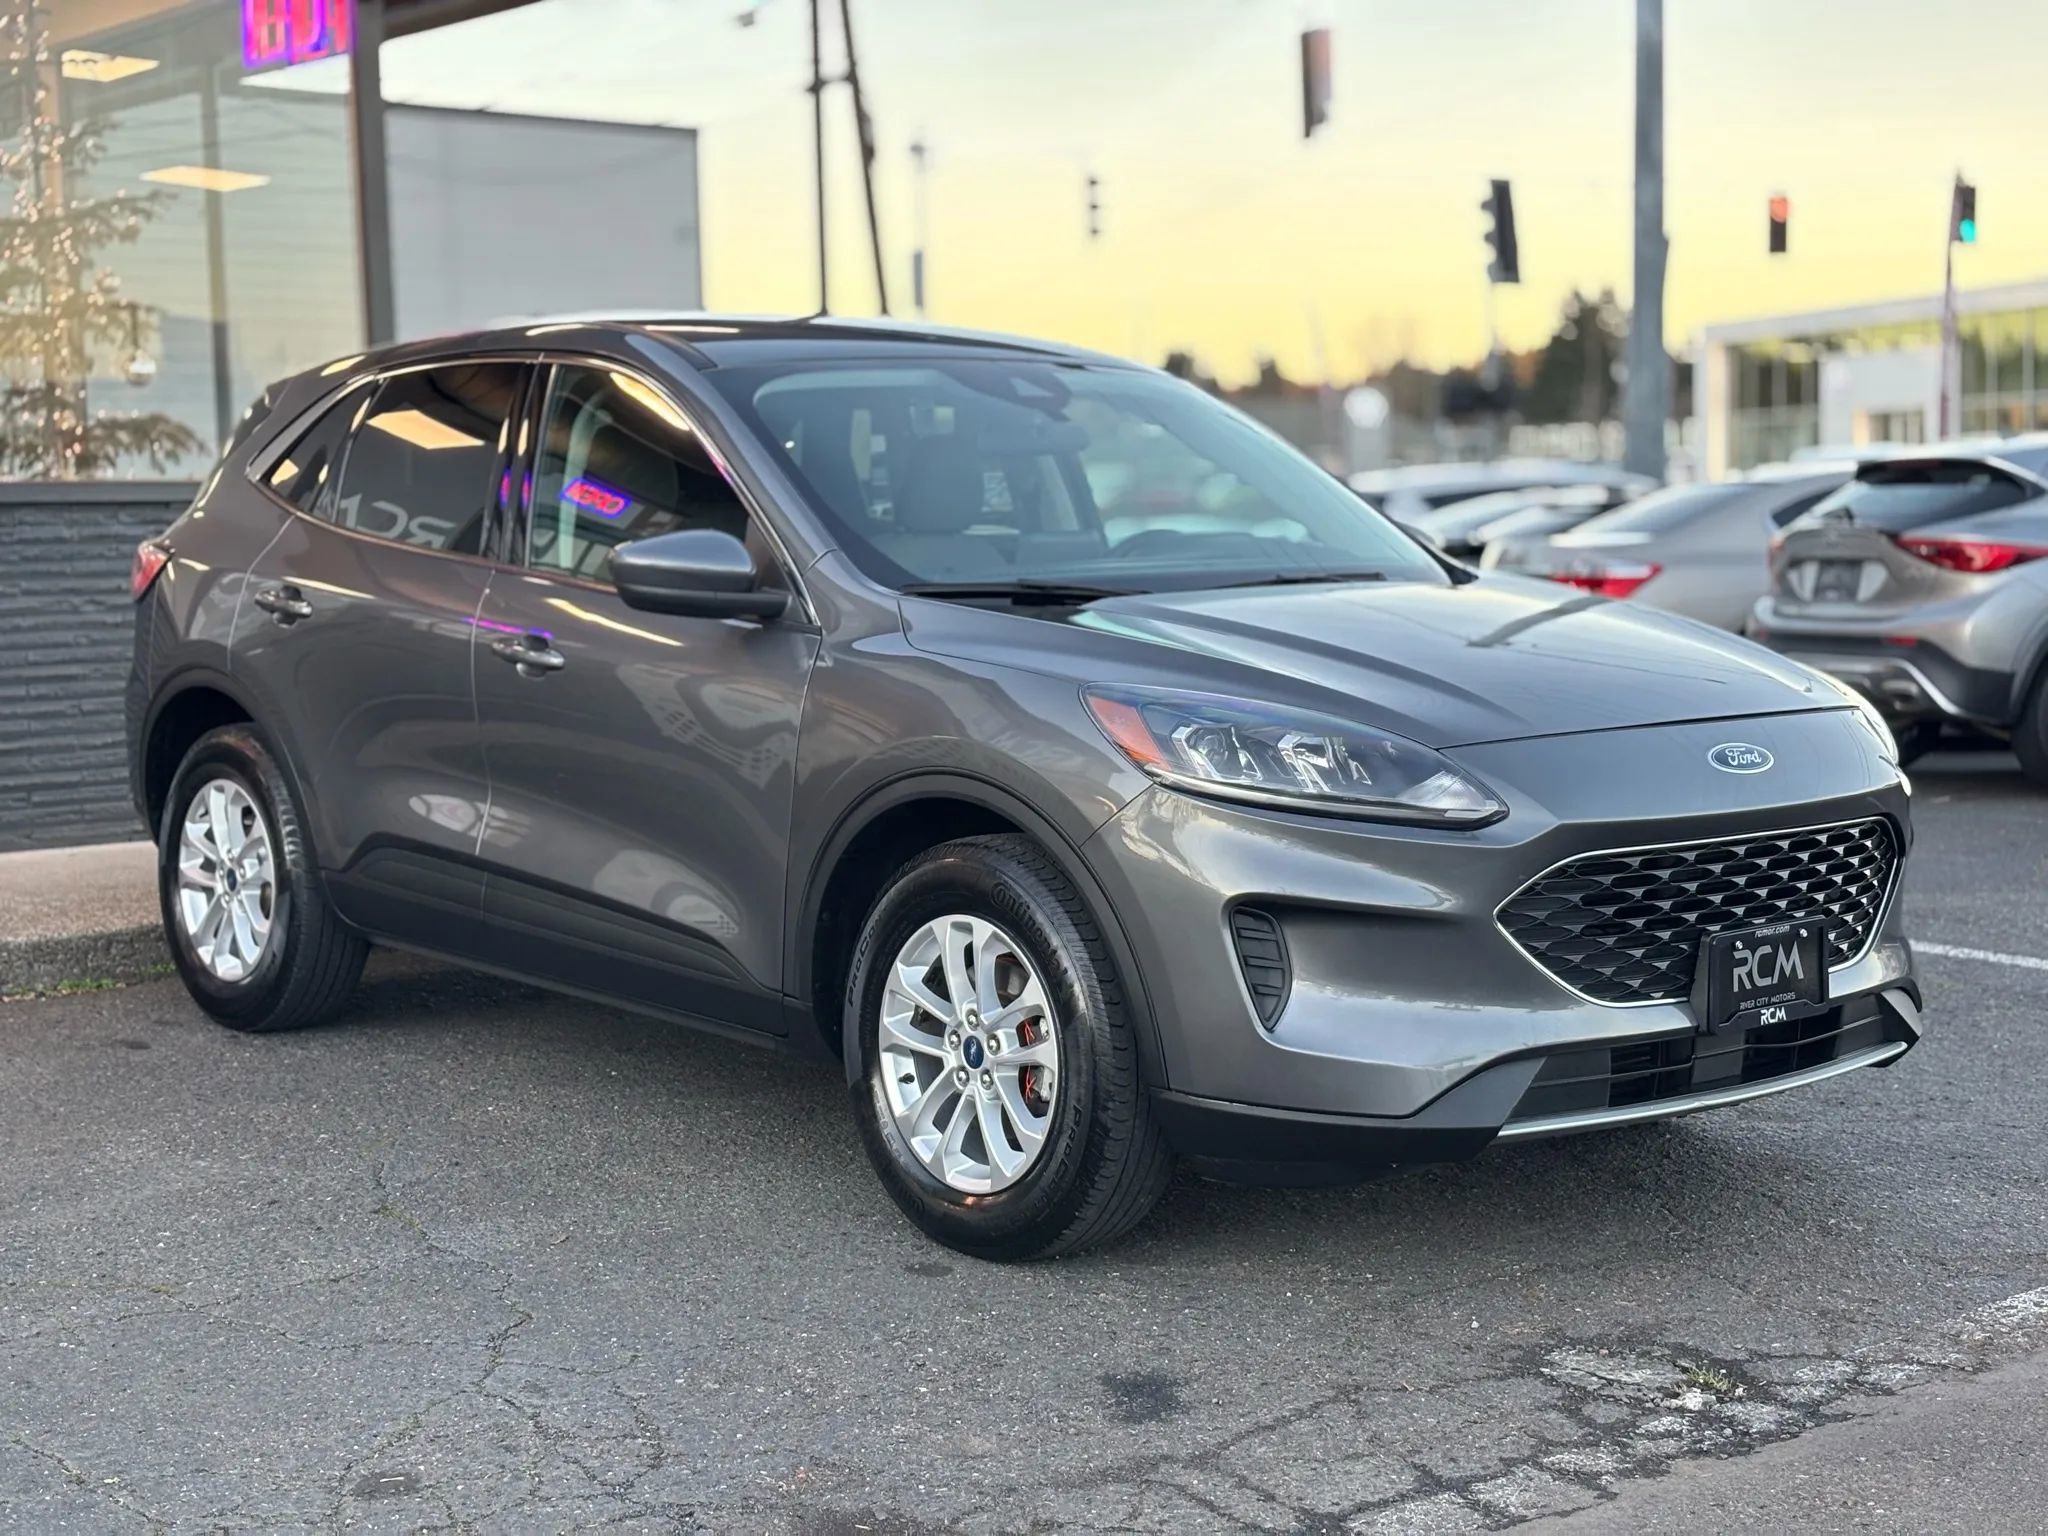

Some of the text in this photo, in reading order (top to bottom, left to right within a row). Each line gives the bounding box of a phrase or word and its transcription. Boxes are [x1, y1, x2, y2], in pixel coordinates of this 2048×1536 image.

[1725, 747, 1762, 766] Ford
[1733, 940, 1804, 993] RCM
[1739, 992, 1796, 1010] RIVER CITY MOTORS
[1760, 1006, 1787, 1026] RCM
